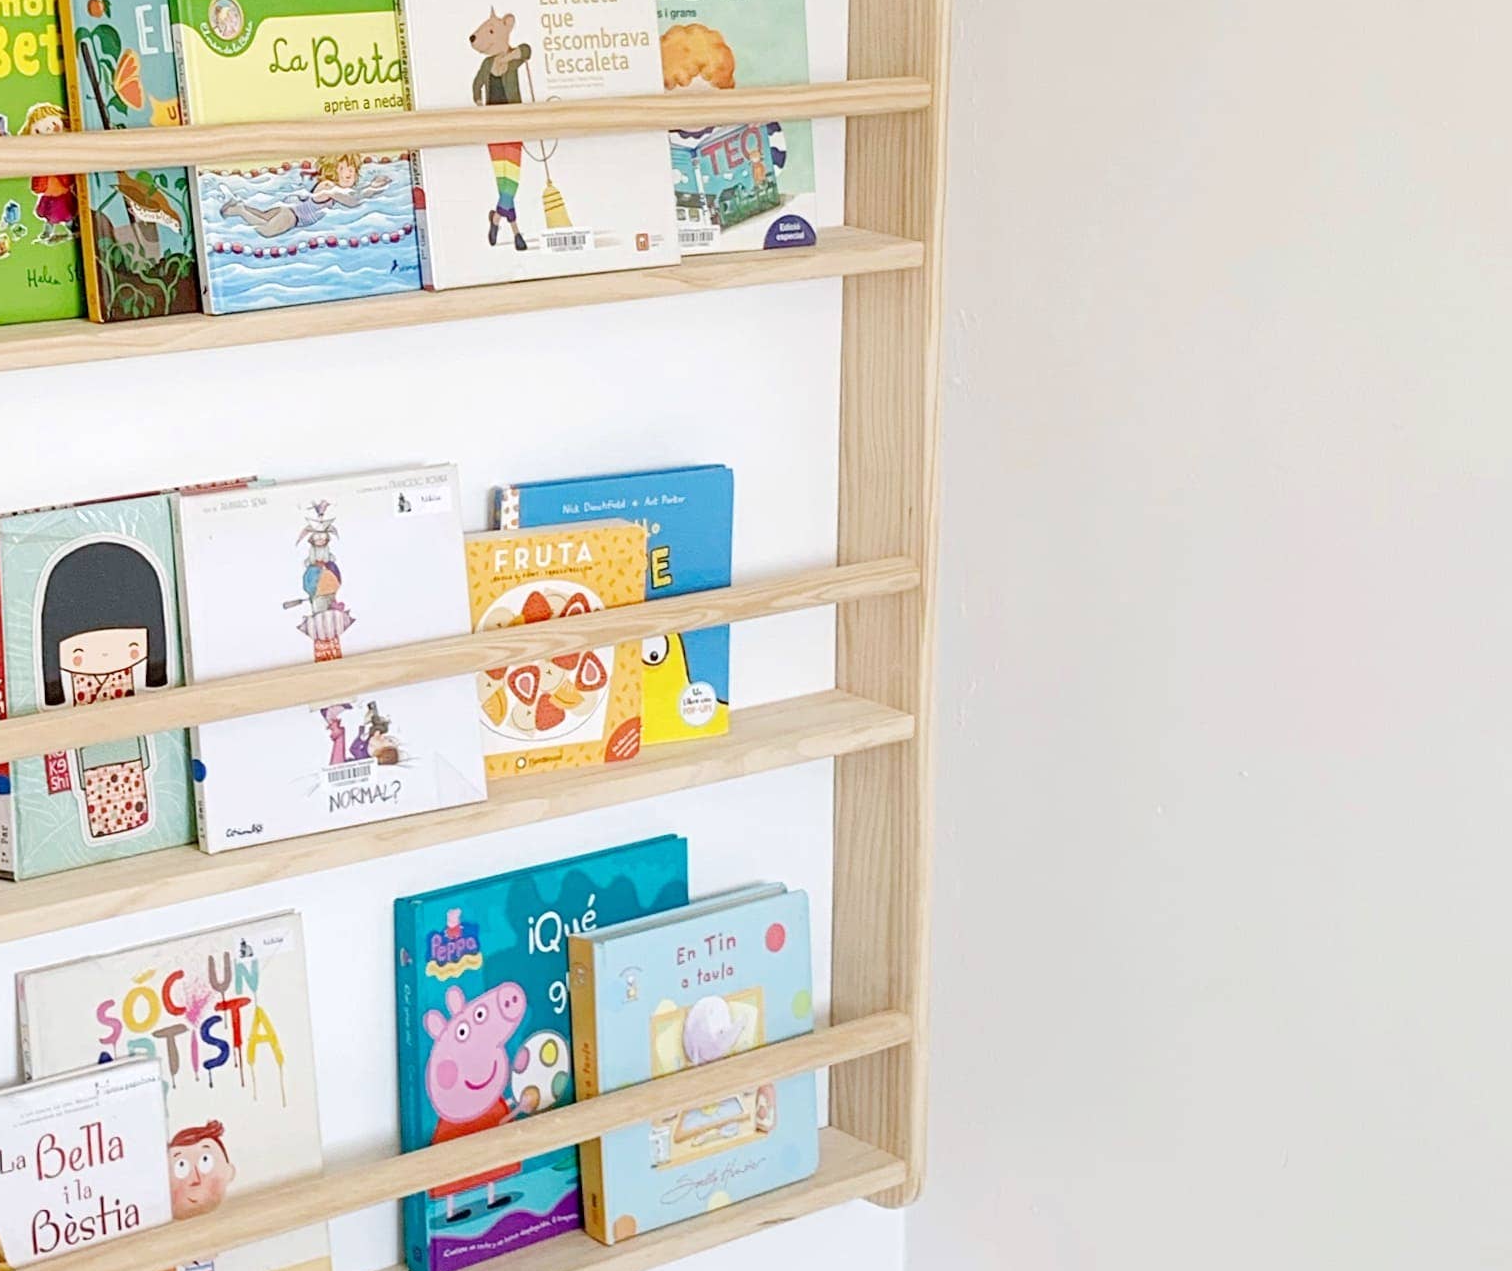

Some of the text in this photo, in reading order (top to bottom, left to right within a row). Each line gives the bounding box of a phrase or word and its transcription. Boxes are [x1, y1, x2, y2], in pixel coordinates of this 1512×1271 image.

[540, 11, 574, 35] que
[670, 8, 697, 20] grans
[543, 27, 650, 52] escombrava
[269, 36, 403, 88] La Berta
[544, 50, 629, 75] l'escaleta
[324, 93, 404, 114] aprèn a neda
[700, 126, 764, 175] TEO
[27, 265, 62, 288] Helen
[494, 541, 593, 572] FRUTA
[329, 780, 402, 813] NORMAL?
[431, 934, 477, 962] Peppa
[677, 933, 736, 966] En Tin
[681, 962, 734, 988] a taula
[96, 951, 258, 1046] SÓC UN
[97, 997, 286, 1080] TISTA
[36, 1121, 124, 1181] Bella
[63, 1179, 93, 1204] i la
[31, 1195, 140, 1255] Bèstia
